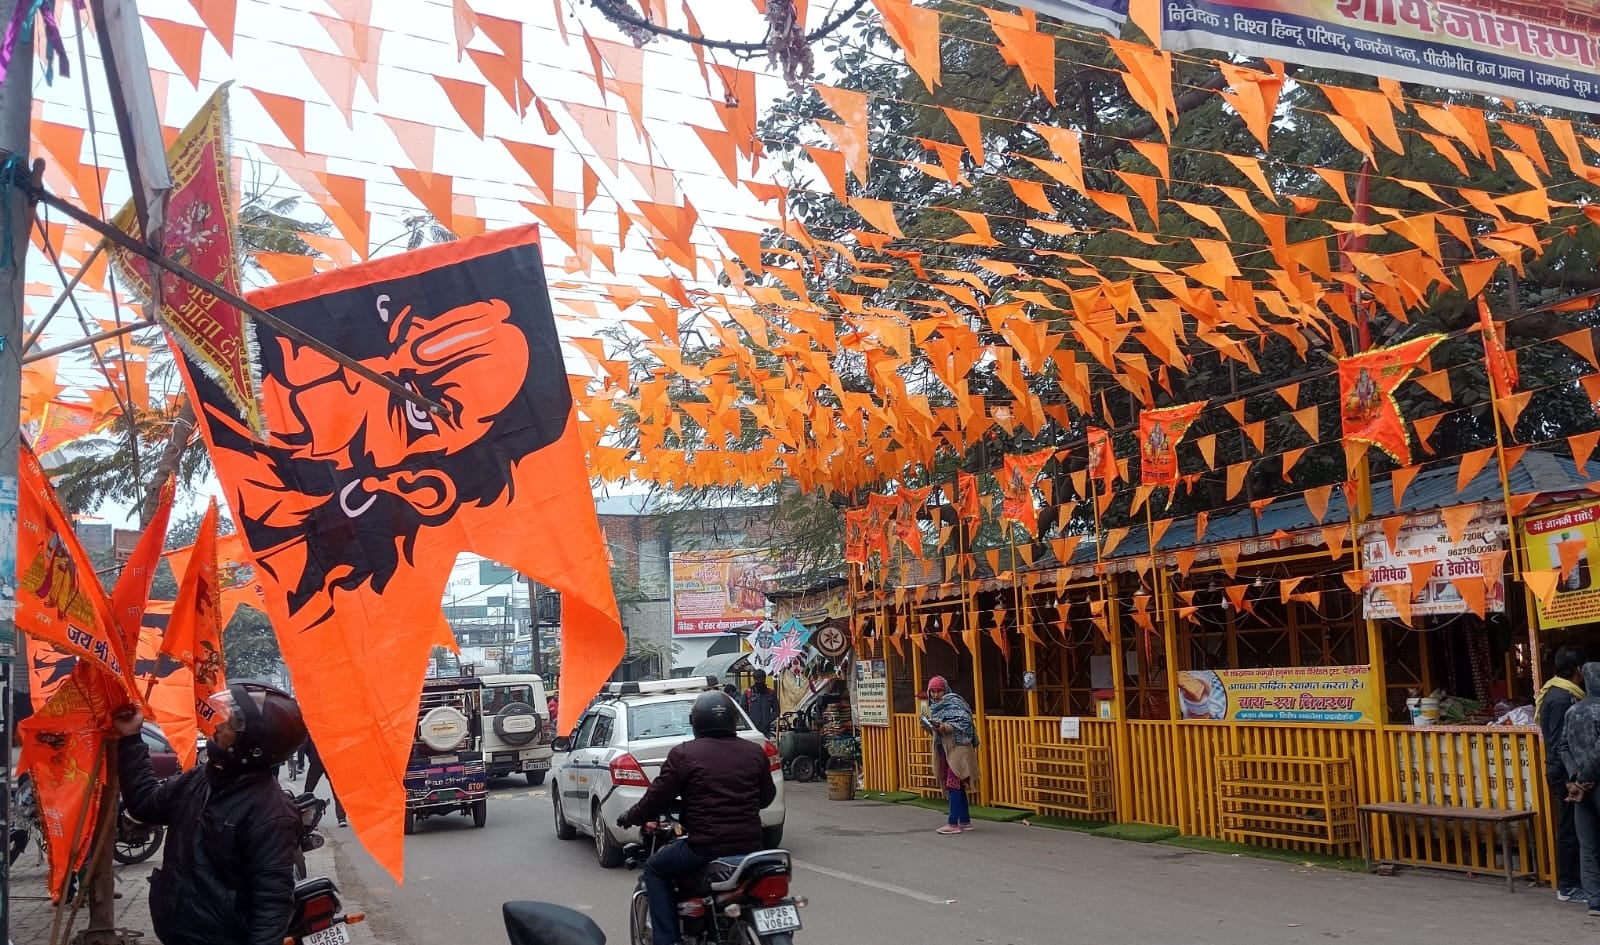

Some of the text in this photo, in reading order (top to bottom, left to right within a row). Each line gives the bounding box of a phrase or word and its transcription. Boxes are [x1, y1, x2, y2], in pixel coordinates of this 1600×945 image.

[1438, 2, 1594, 67] जागरण
[1168, 3, 1220, 27] निवेदक
[1233, 13, 1267, 36] विश्व
[1271, 18, 1305, 47] हिन्दू
[1307, 25, 1351, 53] परिषद्,
[1355, 36, 1393, 56] बजरंग
[1394, 46, 1420, 64] दल,
[1422, 47, 1474, 73] पीलीभीत
[1476, 61, 1496, 77] ब्रज
[1499, 64, 1525, 82] प्रान्त
[1535, 71, 1570, 90] सम्पर्क
[1572, 79, 1591, 98] सूत्र
[179, 296, 241, 359] माता दी
[1370, 564, 1407, 583] अभिषेक
[67, 623, 94, 650] जय
[94, 640, 109, 664] श्री
[1299, 692, 1354, 710] वितरण
[763, 907, 789, 919] UP26
[310, 926, 342, 944] UP26A
